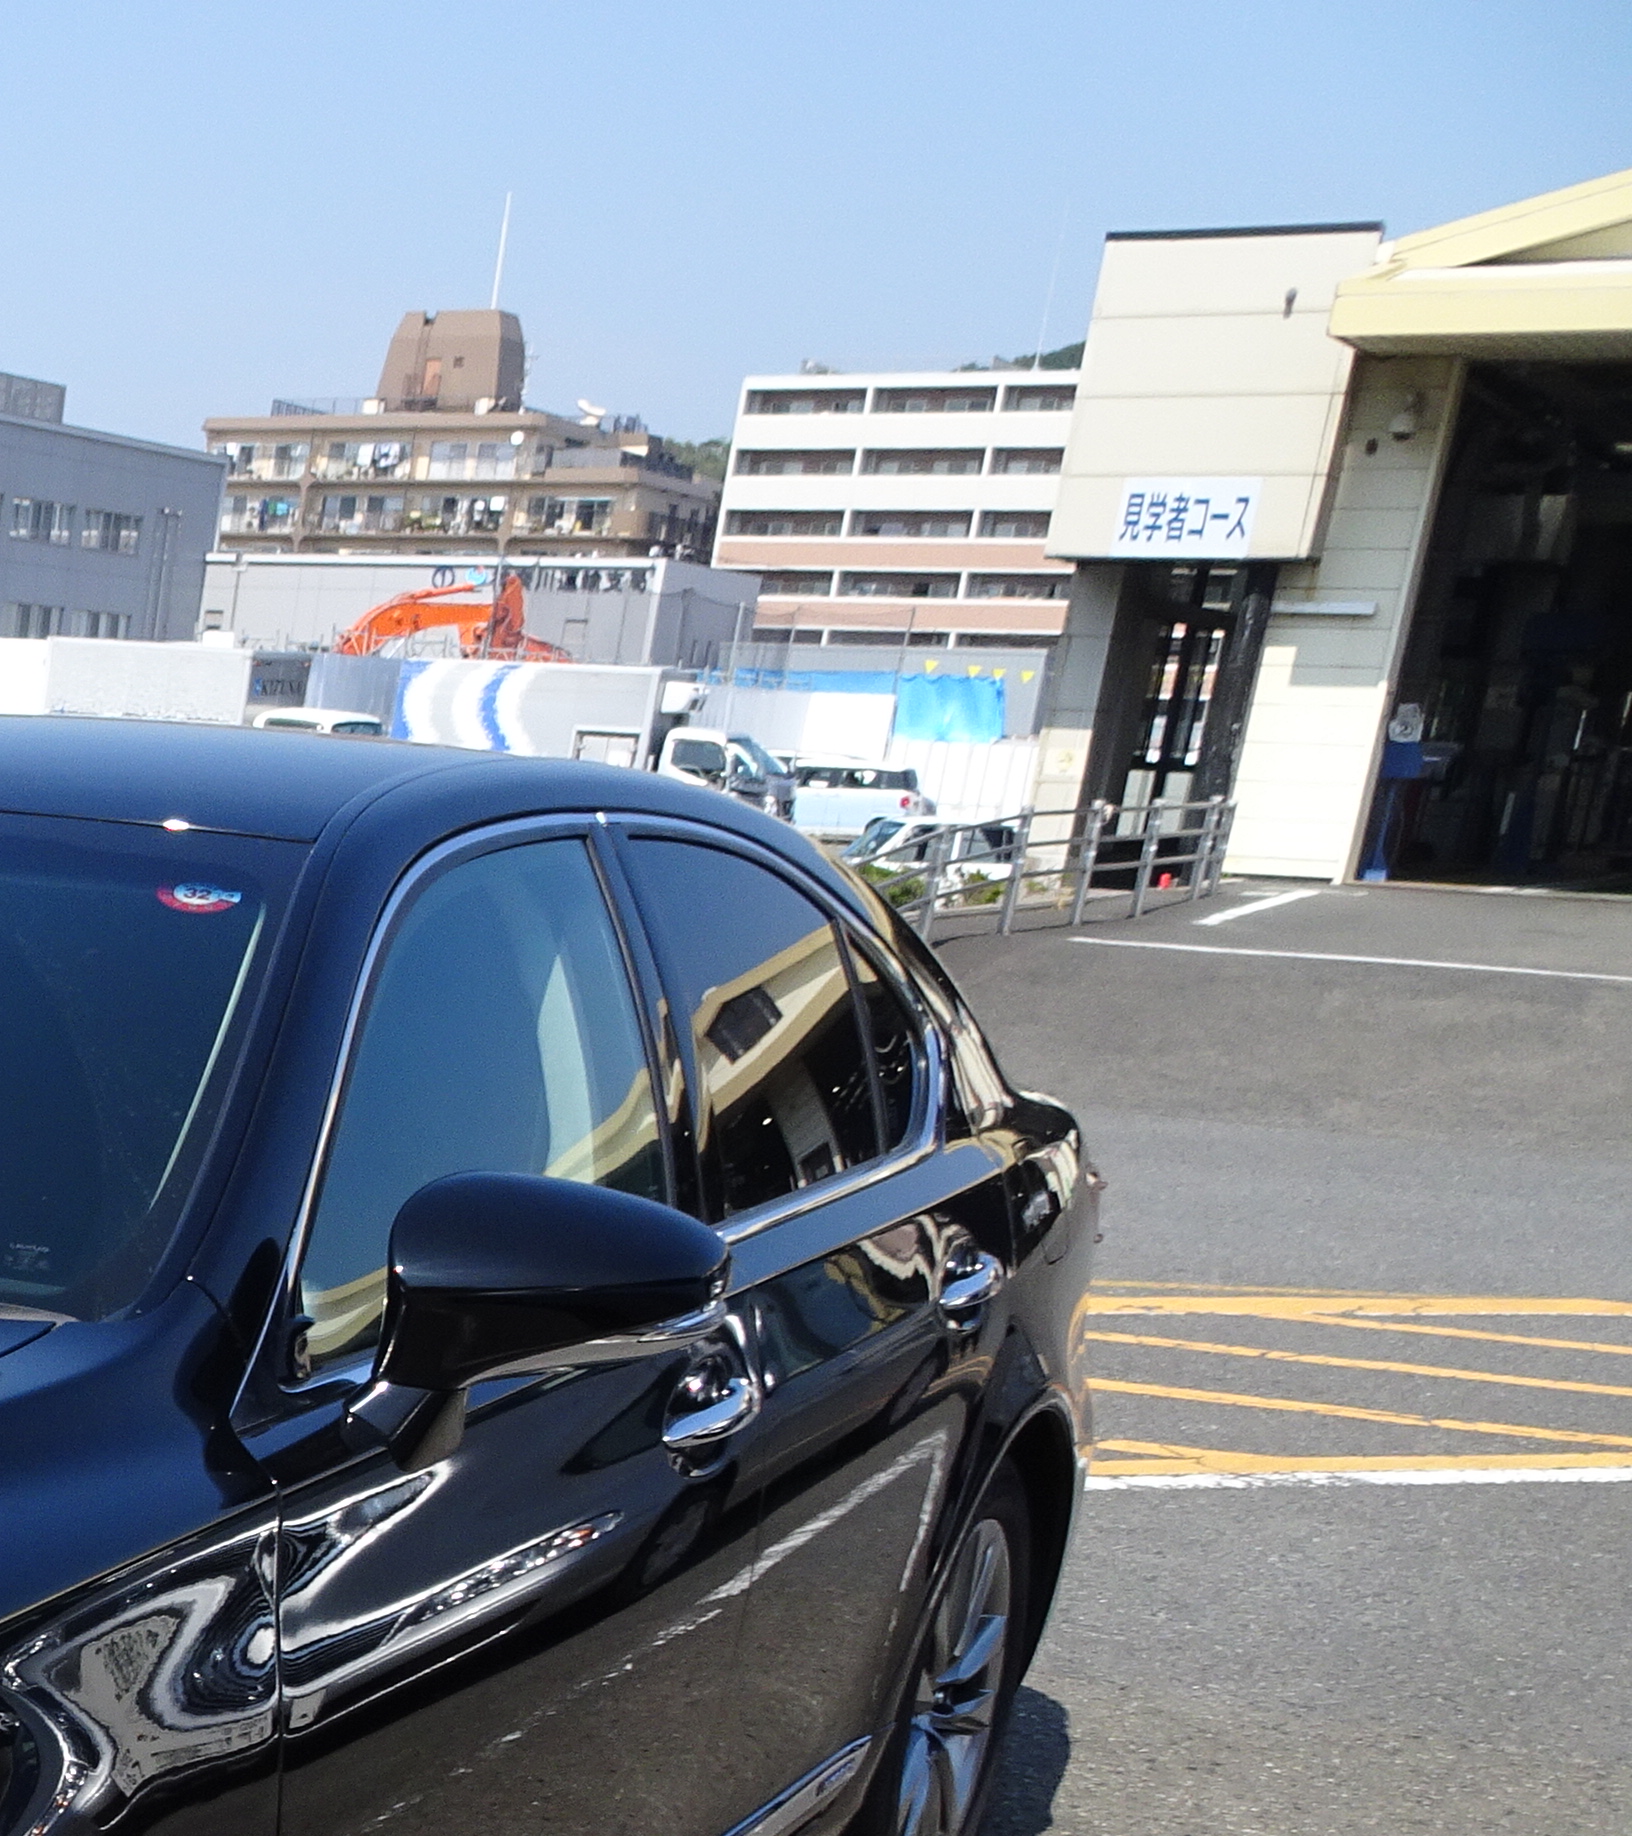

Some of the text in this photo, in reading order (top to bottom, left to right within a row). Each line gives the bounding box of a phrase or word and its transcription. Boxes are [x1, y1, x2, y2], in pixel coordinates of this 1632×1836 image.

[1118, 492, 1251, 542] 見学者コース
[182, 887, 213, 901] 32
